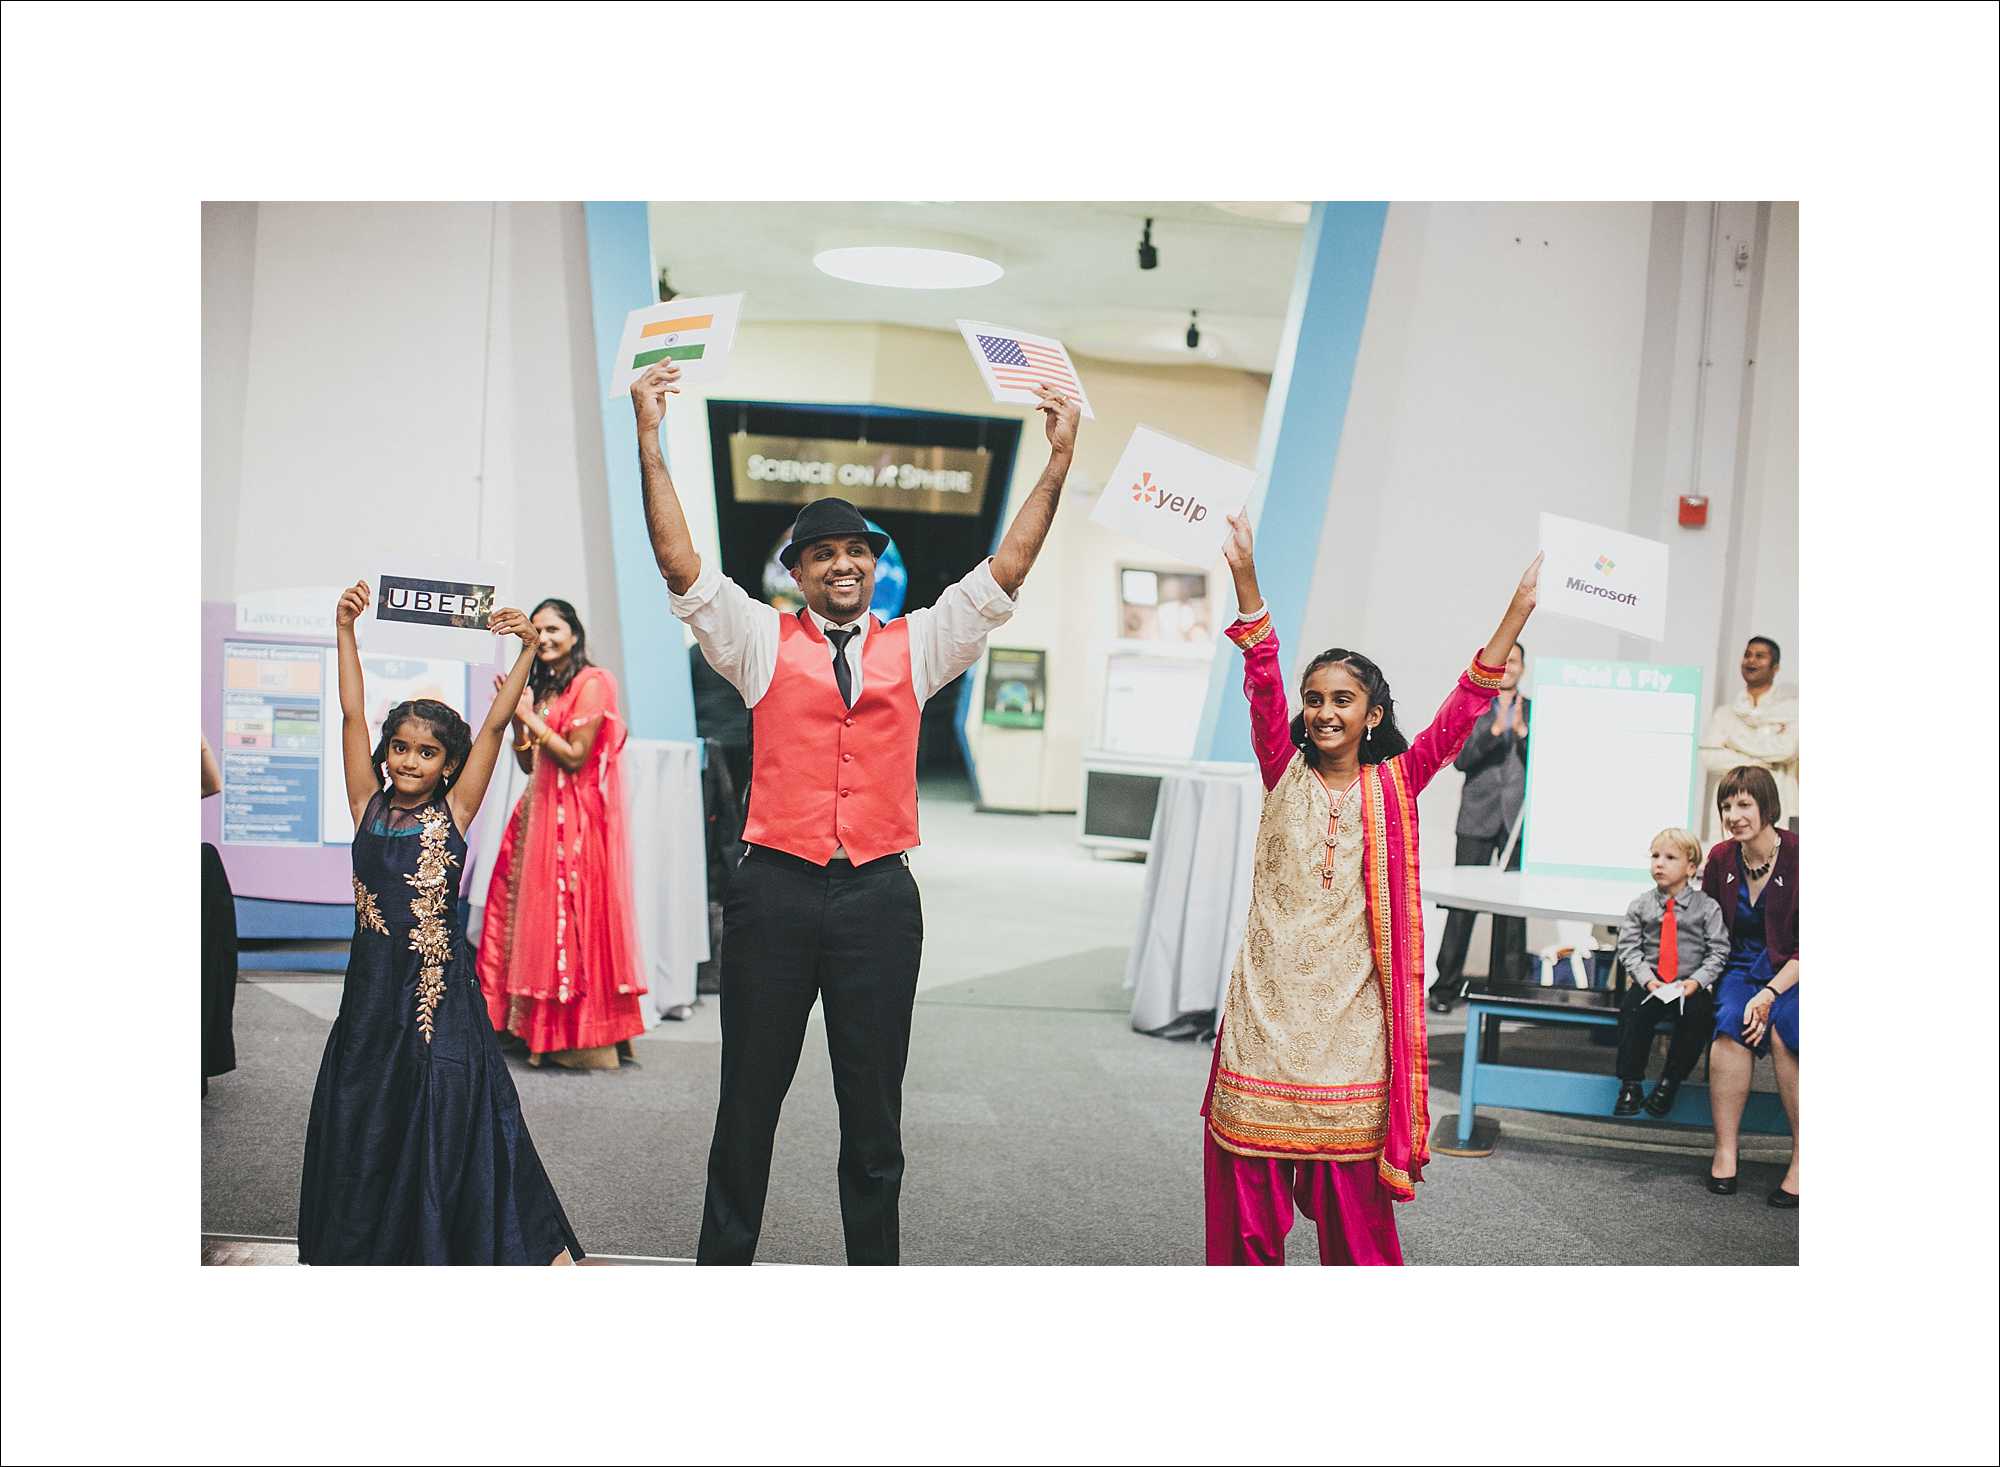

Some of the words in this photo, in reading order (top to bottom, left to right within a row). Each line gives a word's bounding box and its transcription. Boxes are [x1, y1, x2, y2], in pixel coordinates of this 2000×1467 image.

[747, 454, 834, 484] SCIENCE
[838, 463, 875, 486] ON
[876, 465, 898, 487] A
[899, 464, 973, 493] SPHERE
[1154, 489, 1207, 523] yelp
[389, 589, 480, 616] UBER
[1565, 577, 1638, 606] Microsoft
[244, 607, 331, 626] Lawrence
[1637, 669, 1673, 695] Fly
